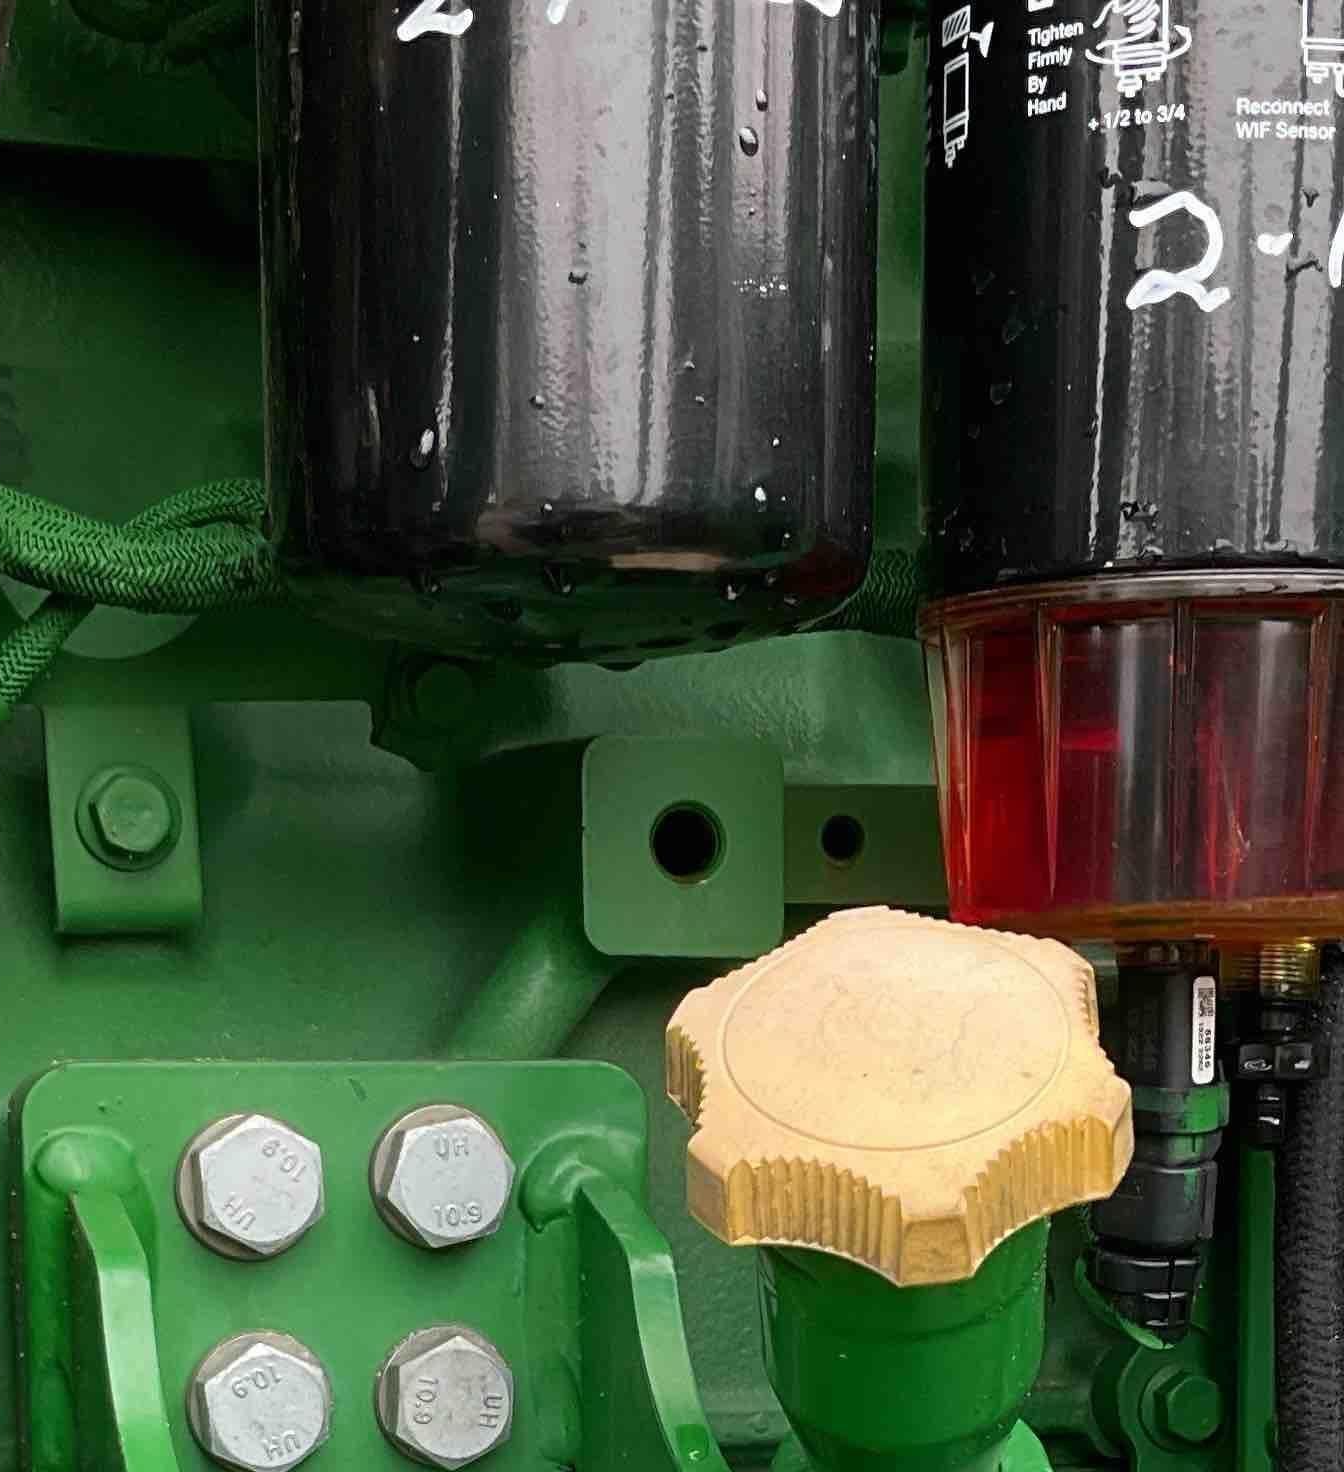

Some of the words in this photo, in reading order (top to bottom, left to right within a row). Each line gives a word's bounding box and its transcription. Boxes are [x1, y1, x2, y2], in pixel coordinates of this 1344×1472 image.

[1028, 22, 1084, 47] Tighten
[1028, 45, 1073, 70] Firmly
[1028, 75, 1048, 95] By
[1028, 91, 1067, 117] Hand
[1104, 109, 1131, 129] 1/2
[1135, 109, 1153, 125] to
[1157, 104, 1186, 122] 3/4
[1236, 97, 1331, 115] Reconnect
[1236, 121, 1271, 138] WIF
[1275, 121, 1336, 139] Sensor
[433, 1134, 471, 1160] UH
[261, 1138, 308, 1184] 10.9
[431, 1200, 483, 1229] 10.9
[231, 1361, 283, 1400] 10.9
[412, 1376, 440, 1425] 10.9
[479, 1392, 504, 1430] UH
